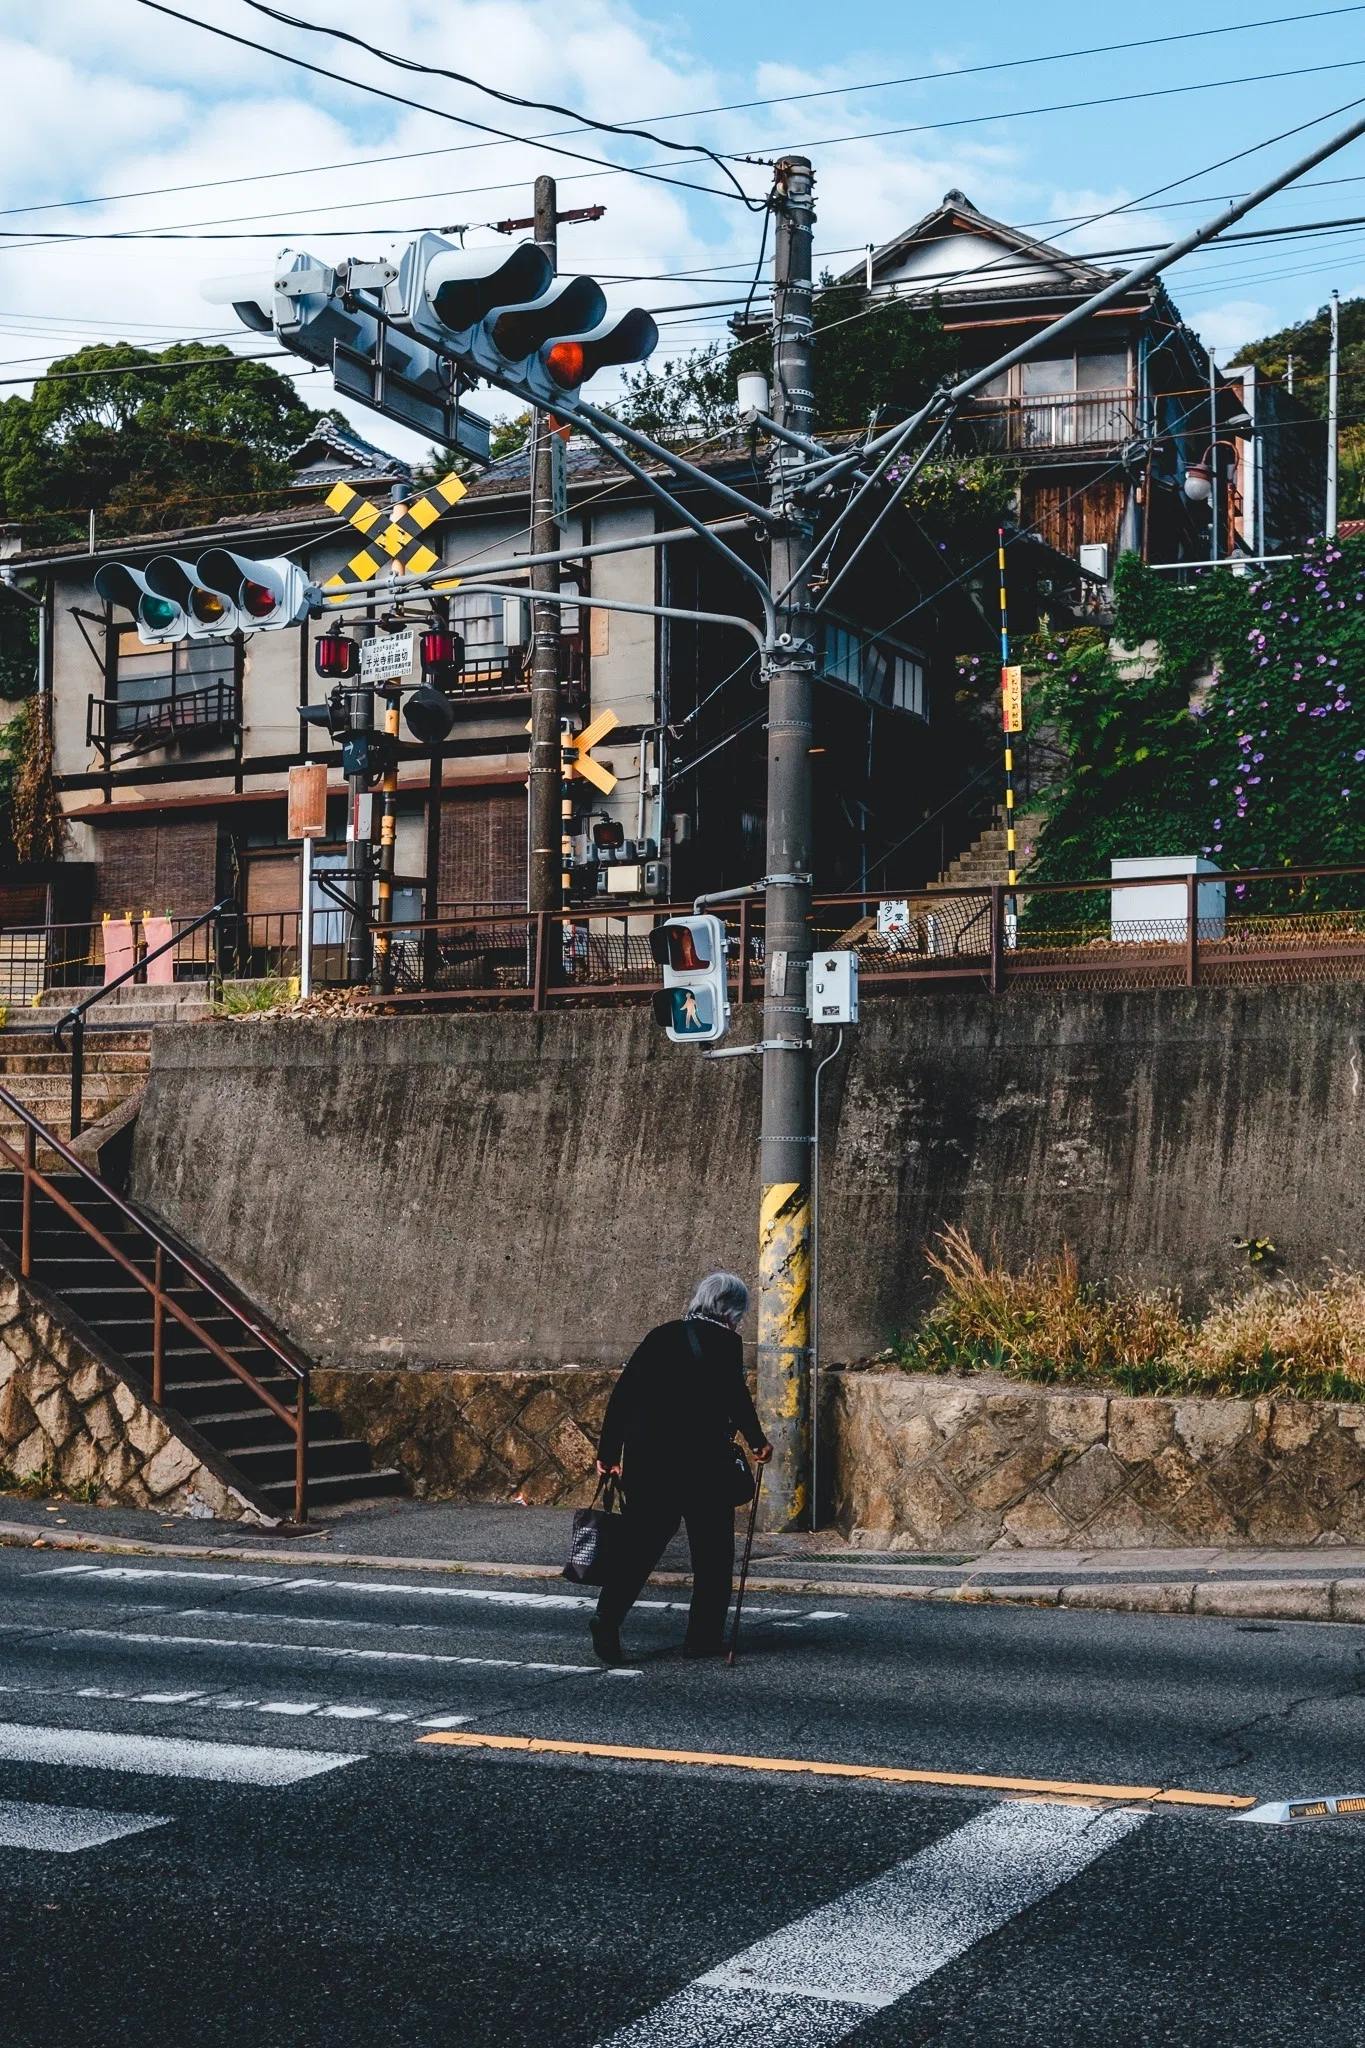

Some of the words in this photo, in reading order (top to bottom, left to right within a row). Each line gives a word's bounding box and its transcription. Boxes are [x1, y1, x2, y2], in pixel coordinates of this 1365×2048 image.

[366, 651, 408, 668] 千光寺前踏切
[1011, 669, 1019, 728] おまちください
